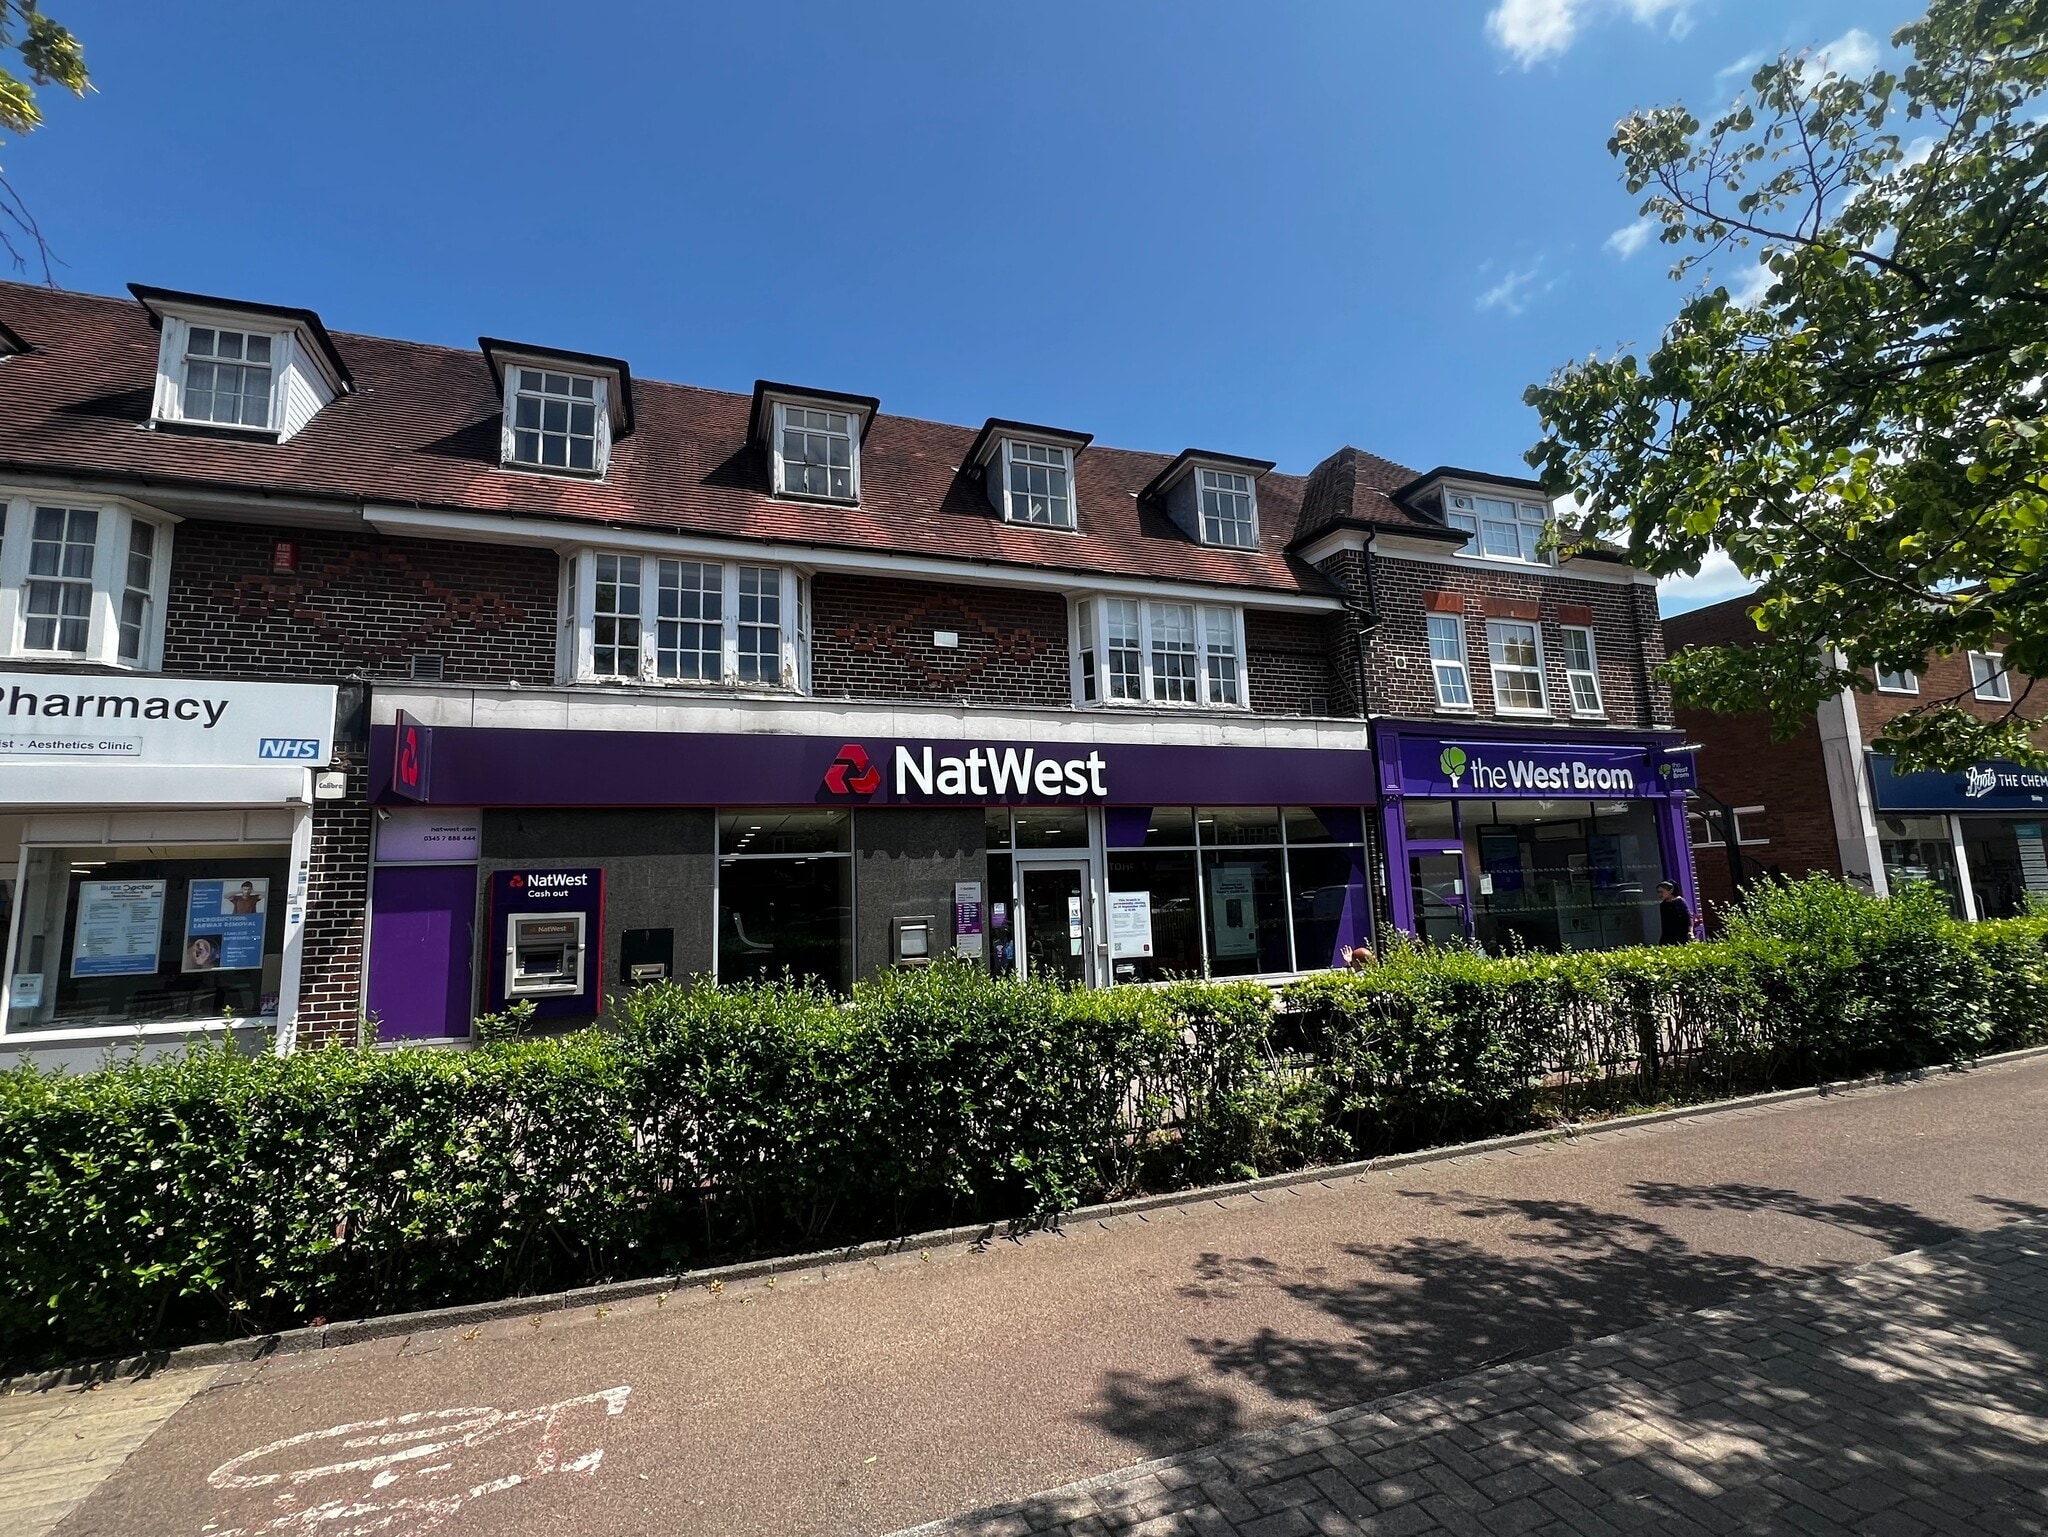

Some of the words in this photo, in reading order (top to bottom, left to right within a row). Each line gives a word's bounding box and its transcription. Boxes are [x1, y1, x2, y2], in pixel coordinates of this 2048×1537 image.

[27, 740, 94, 750] Aesthetics
[98, 741, 134, 751] Clinic
[260, 740, 318, 758] NHS
[895, 745, 1108, 796] NatWest
[1470, 757, 1507, 788] the
[1507, 760, 1570, 789] West
[1572, 761, 1635, 790] Brom
[1965, 766, 1997, 798] Boots
[1998, 774, 2019, 787] THE
[2020, 774, 2048, 787] CHEM
[527, 873, 588, 887] NatWest
[528, 890, 551, 898] Cash
